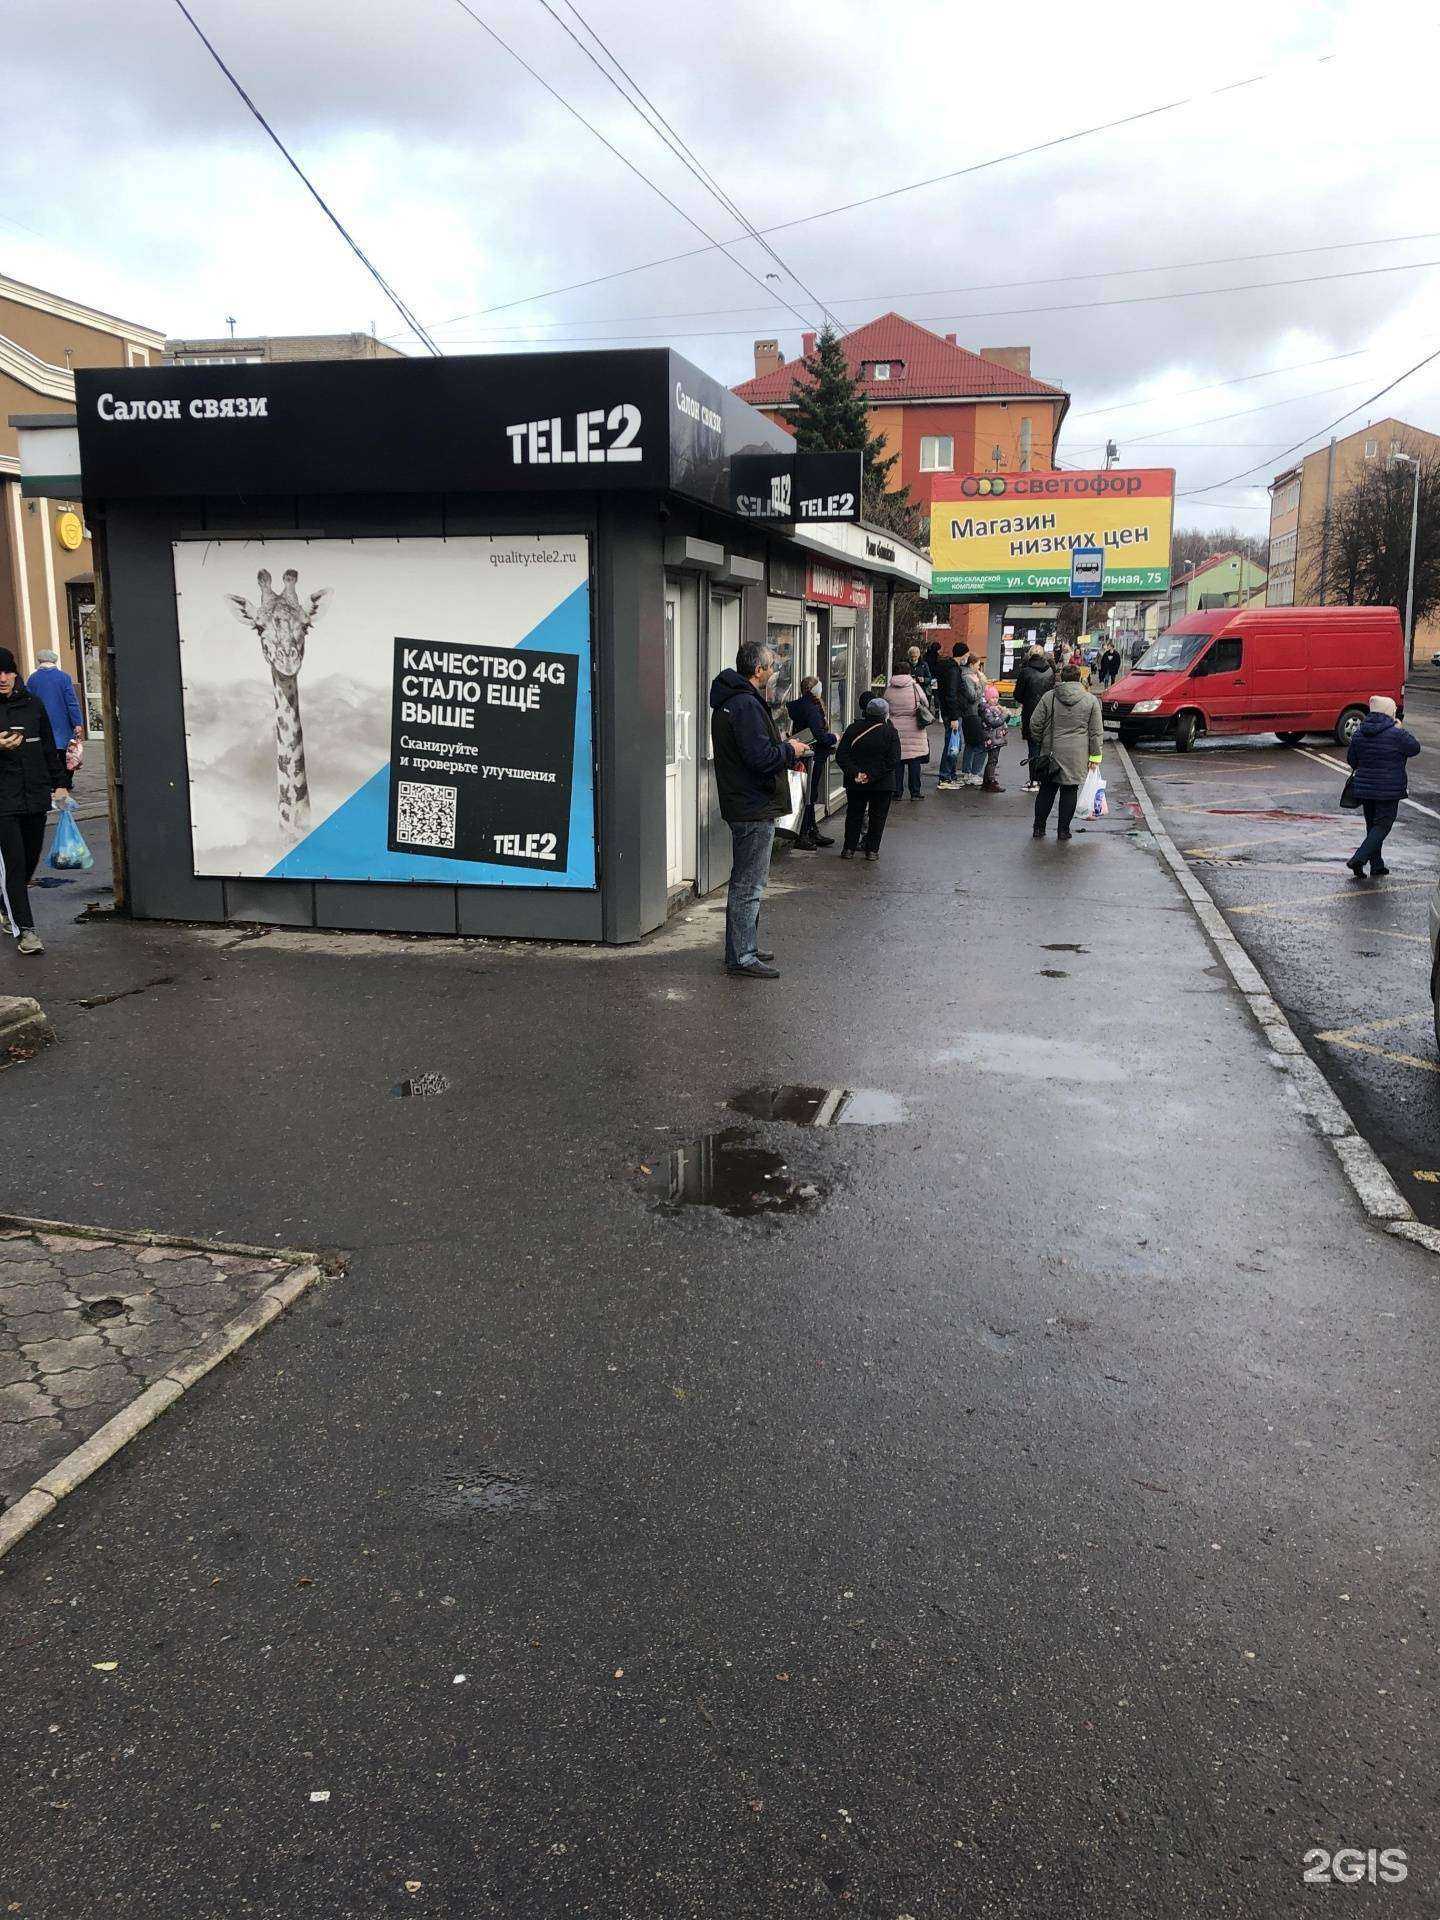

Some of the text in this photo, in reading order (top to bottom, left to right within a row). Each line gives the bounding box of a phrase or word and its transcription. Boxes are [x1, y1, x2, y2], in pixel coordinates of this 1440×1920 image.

[97, 393, 268, 420] Салон связи
[676, 382, 700, 420] Салон
[506, 403, 643, 464] TELE2
[1014, 475, 1142, 496] светофор
[800, 493, 855, 517] TELE2
[951, 513, 1056, 539] Магазин
[1010, 526, 1149, 556] низких цен
[490, 550, 577, 567] quality.tele2.ru
[1007, 576, 1024, 588] ул.
[1147, 572, 1162, 584] 75
[403, 648, 565, 684] КАЧЕСТВО 4G
[401, 675, 541, 712] СТАЛО ЕЩЁ
[401, 701, 475, 729] ВЫШЕ
[400, 735, 479, 757] Сканируйте
[399, 755, 556, 782] и проверьте улучшения
[493, 832, 557, 861] TELE2
